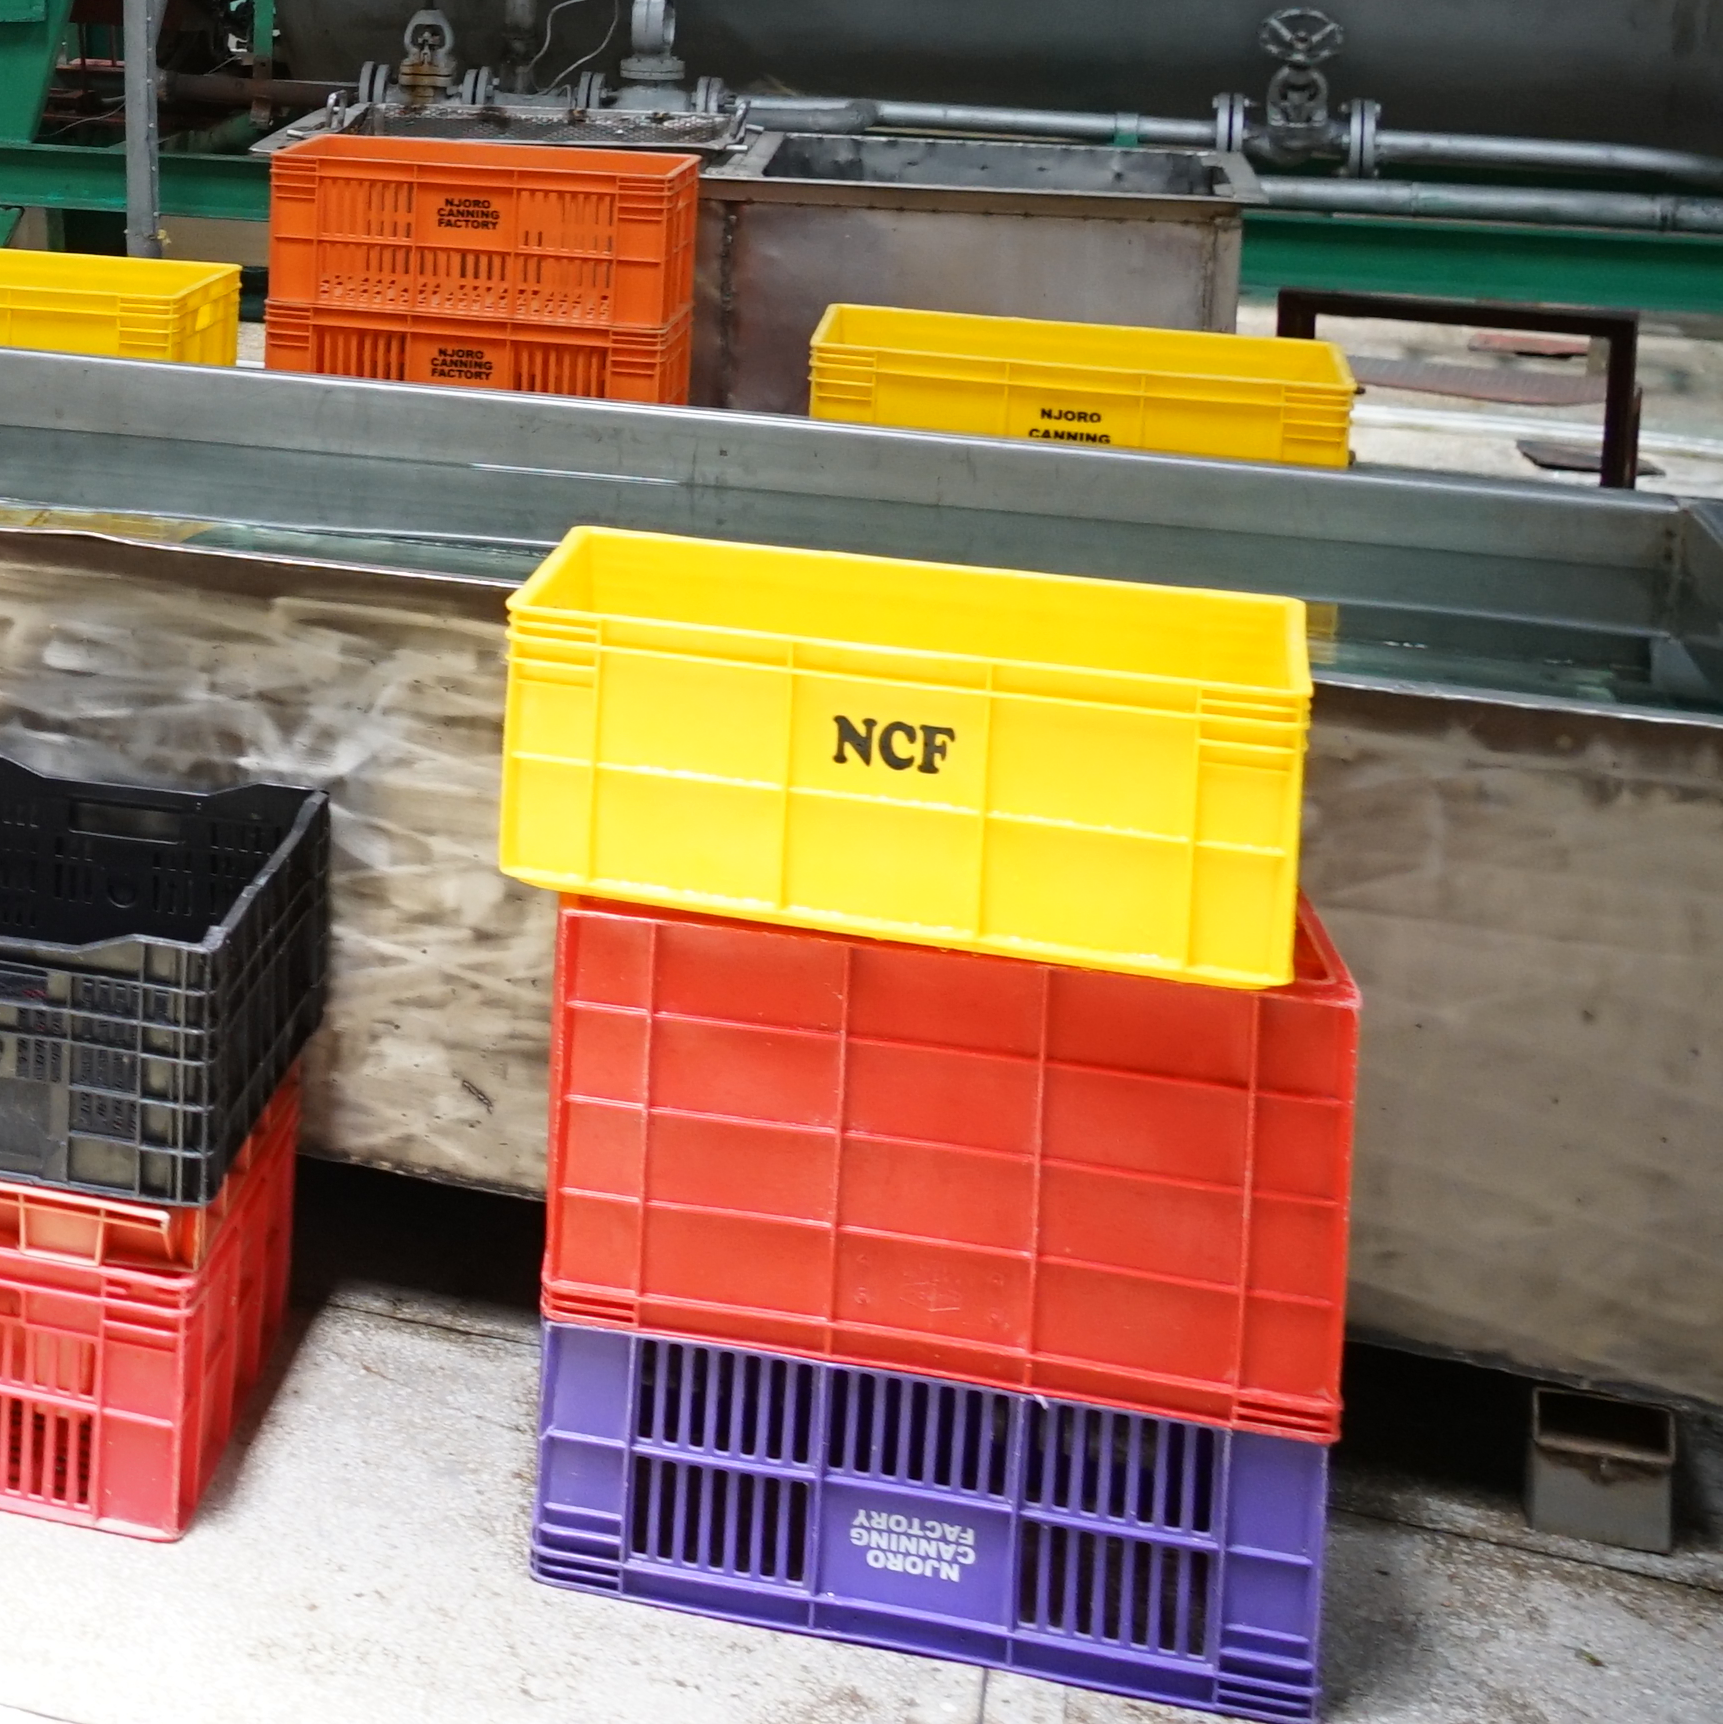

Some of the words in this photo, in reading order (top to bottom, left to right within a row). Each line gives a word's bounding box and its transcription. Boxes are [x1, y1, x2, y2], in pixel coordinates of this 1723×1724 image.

[444, 198, 491, 209] NJORO
[437, 208, 500, 220] CANNING
[437, 218, 499, 230] FACTORY
[438, 348, 484, 359] NJORO
[431, 358, 493, 370] CANNING
[431, 368, 493, 380] FACTORY
[1040, 408, 1102, 423] NJORO
[1028, 428, 1111, 444] CANNING
[833, 714, 956, 775] NCF
[852, 1509, 975, 1546] FACTORY
[849, 1527, 976, 1565] CANNING
[866, 1549, 960, 1582] NJORO
